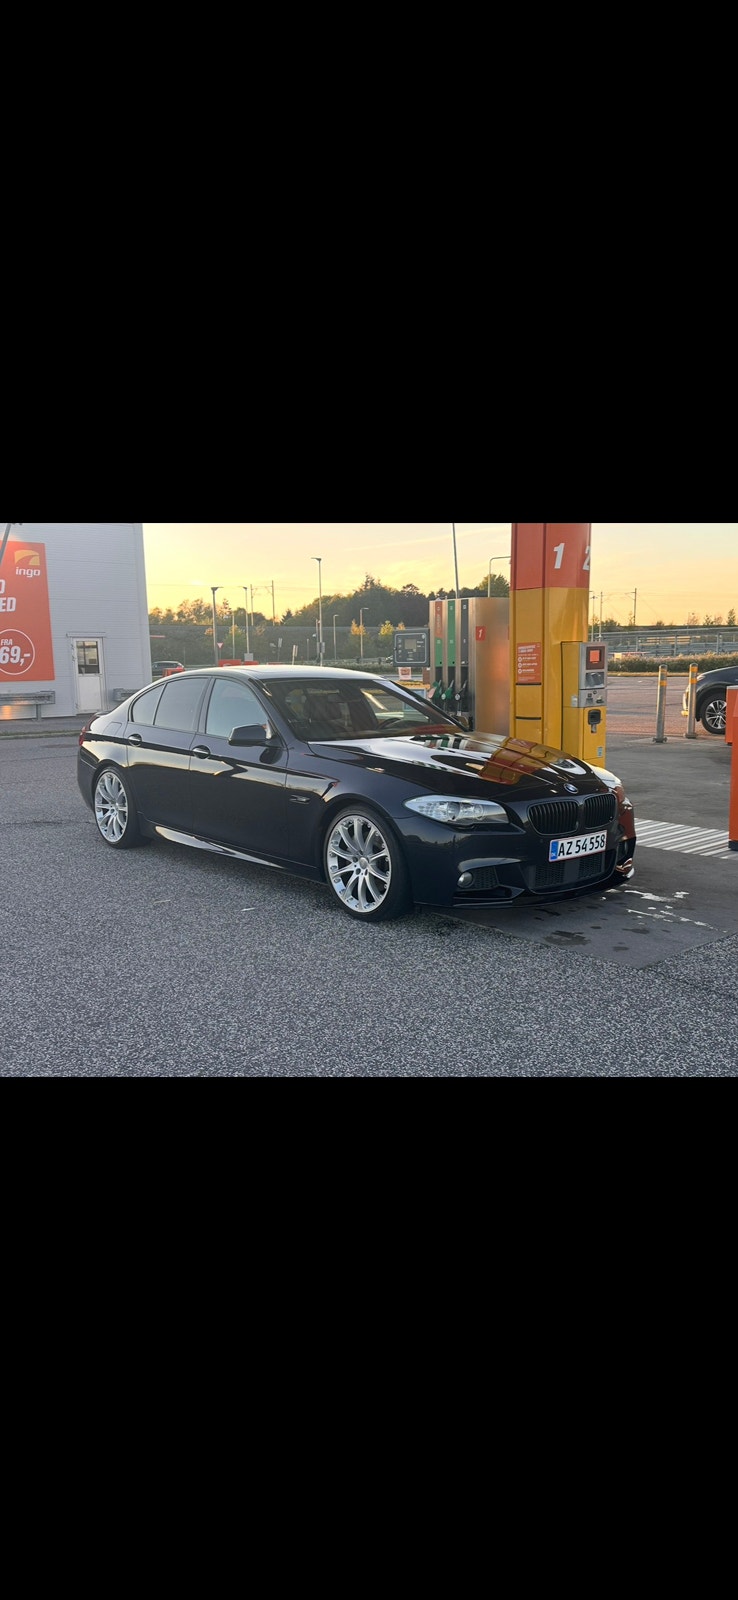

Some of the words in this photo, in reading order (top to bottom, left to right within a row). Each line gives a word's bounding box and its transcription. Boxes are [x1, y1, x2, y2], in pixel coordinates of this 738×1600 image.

[553, 543, 565, 569] 1
[15, 567, 41, 578] ingo
[478, 629, 483, 638] 1
[558, 841, 573, 856] AZ
[575, 838, 588, 853] 54
[589, 834, 605, 850] 558
